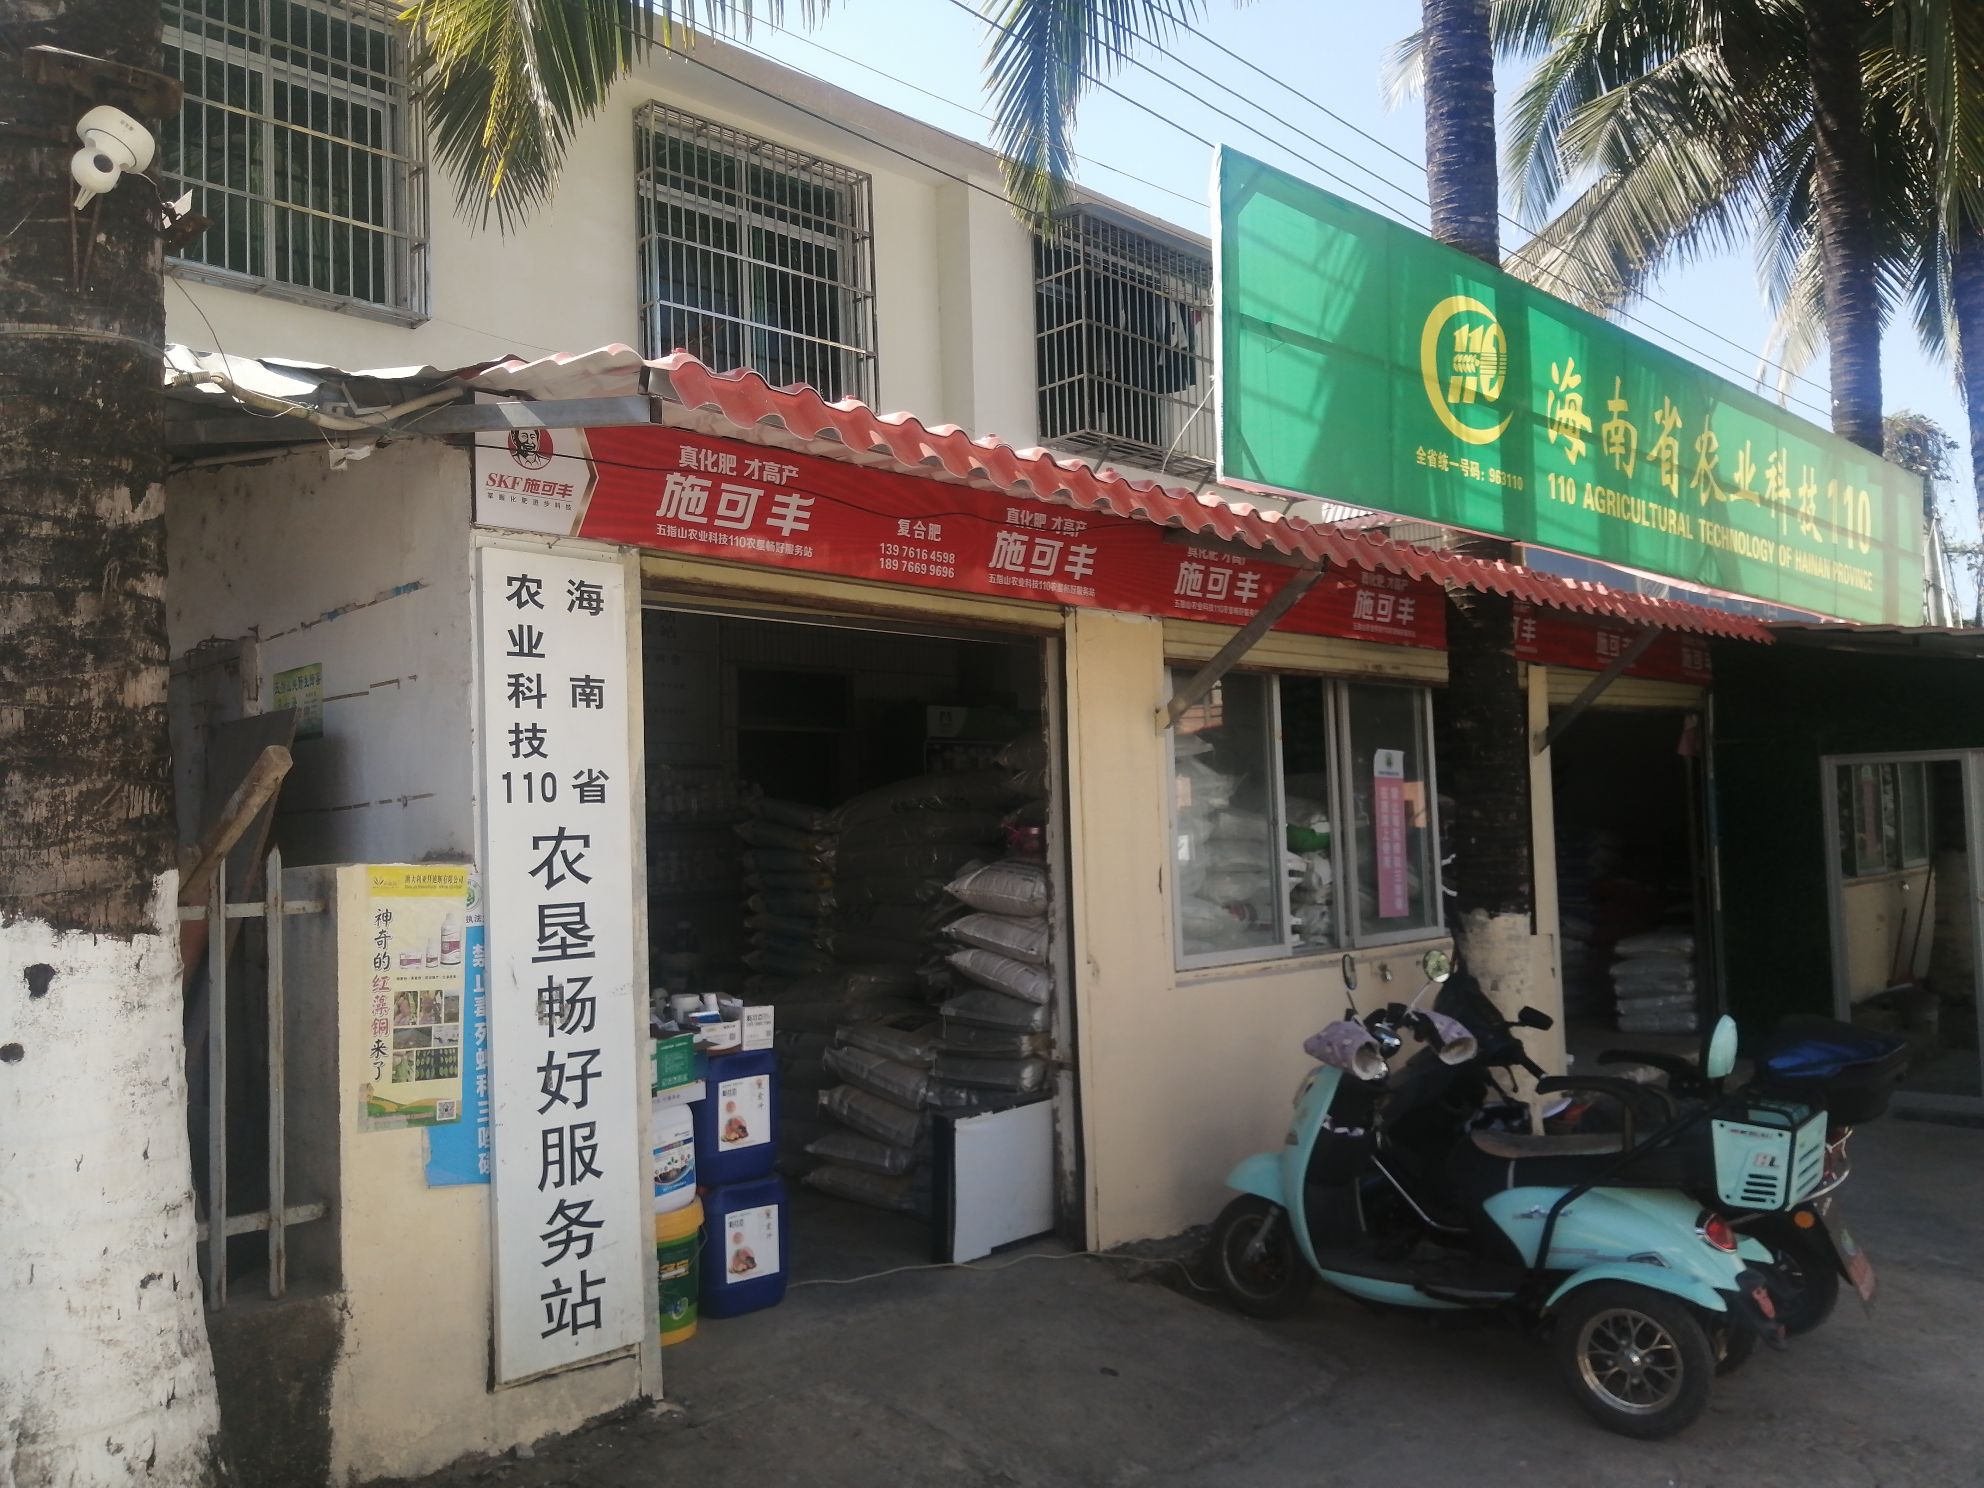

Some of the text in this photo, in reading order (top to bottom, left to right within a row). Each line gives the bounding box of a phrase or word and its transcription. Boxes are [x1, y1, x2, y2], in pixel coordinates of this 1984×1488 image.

[486, 472, 574, 499] SKF 施可丰
[679, 445, 800, 486] 真化肥 才高产
[655, 472, 816, 537] 施可丰
[656, 523, 814, 559] 五指山农业科技110农垦畅好服务站
[896, 518, 942, 542] 复合肥
[1548, 472, 1873, 592] 110 AGRICULTURAL TECHNOLOGY OF HAINAN PROVINCE
[879, 557, 955, 578] 189 7669 9696
[880, 542, 956, 565] 139 7616 4598
[988, 530, 1098, 581] 施可丰
[1174, 560, 1261, 604] 施可丰
[566, 579, 610, 804] 海南省
[371, 908, 392, 1081] 神奇的红藻铜来了
[528, 826, 606, 1340] 农垦畅好服务站
